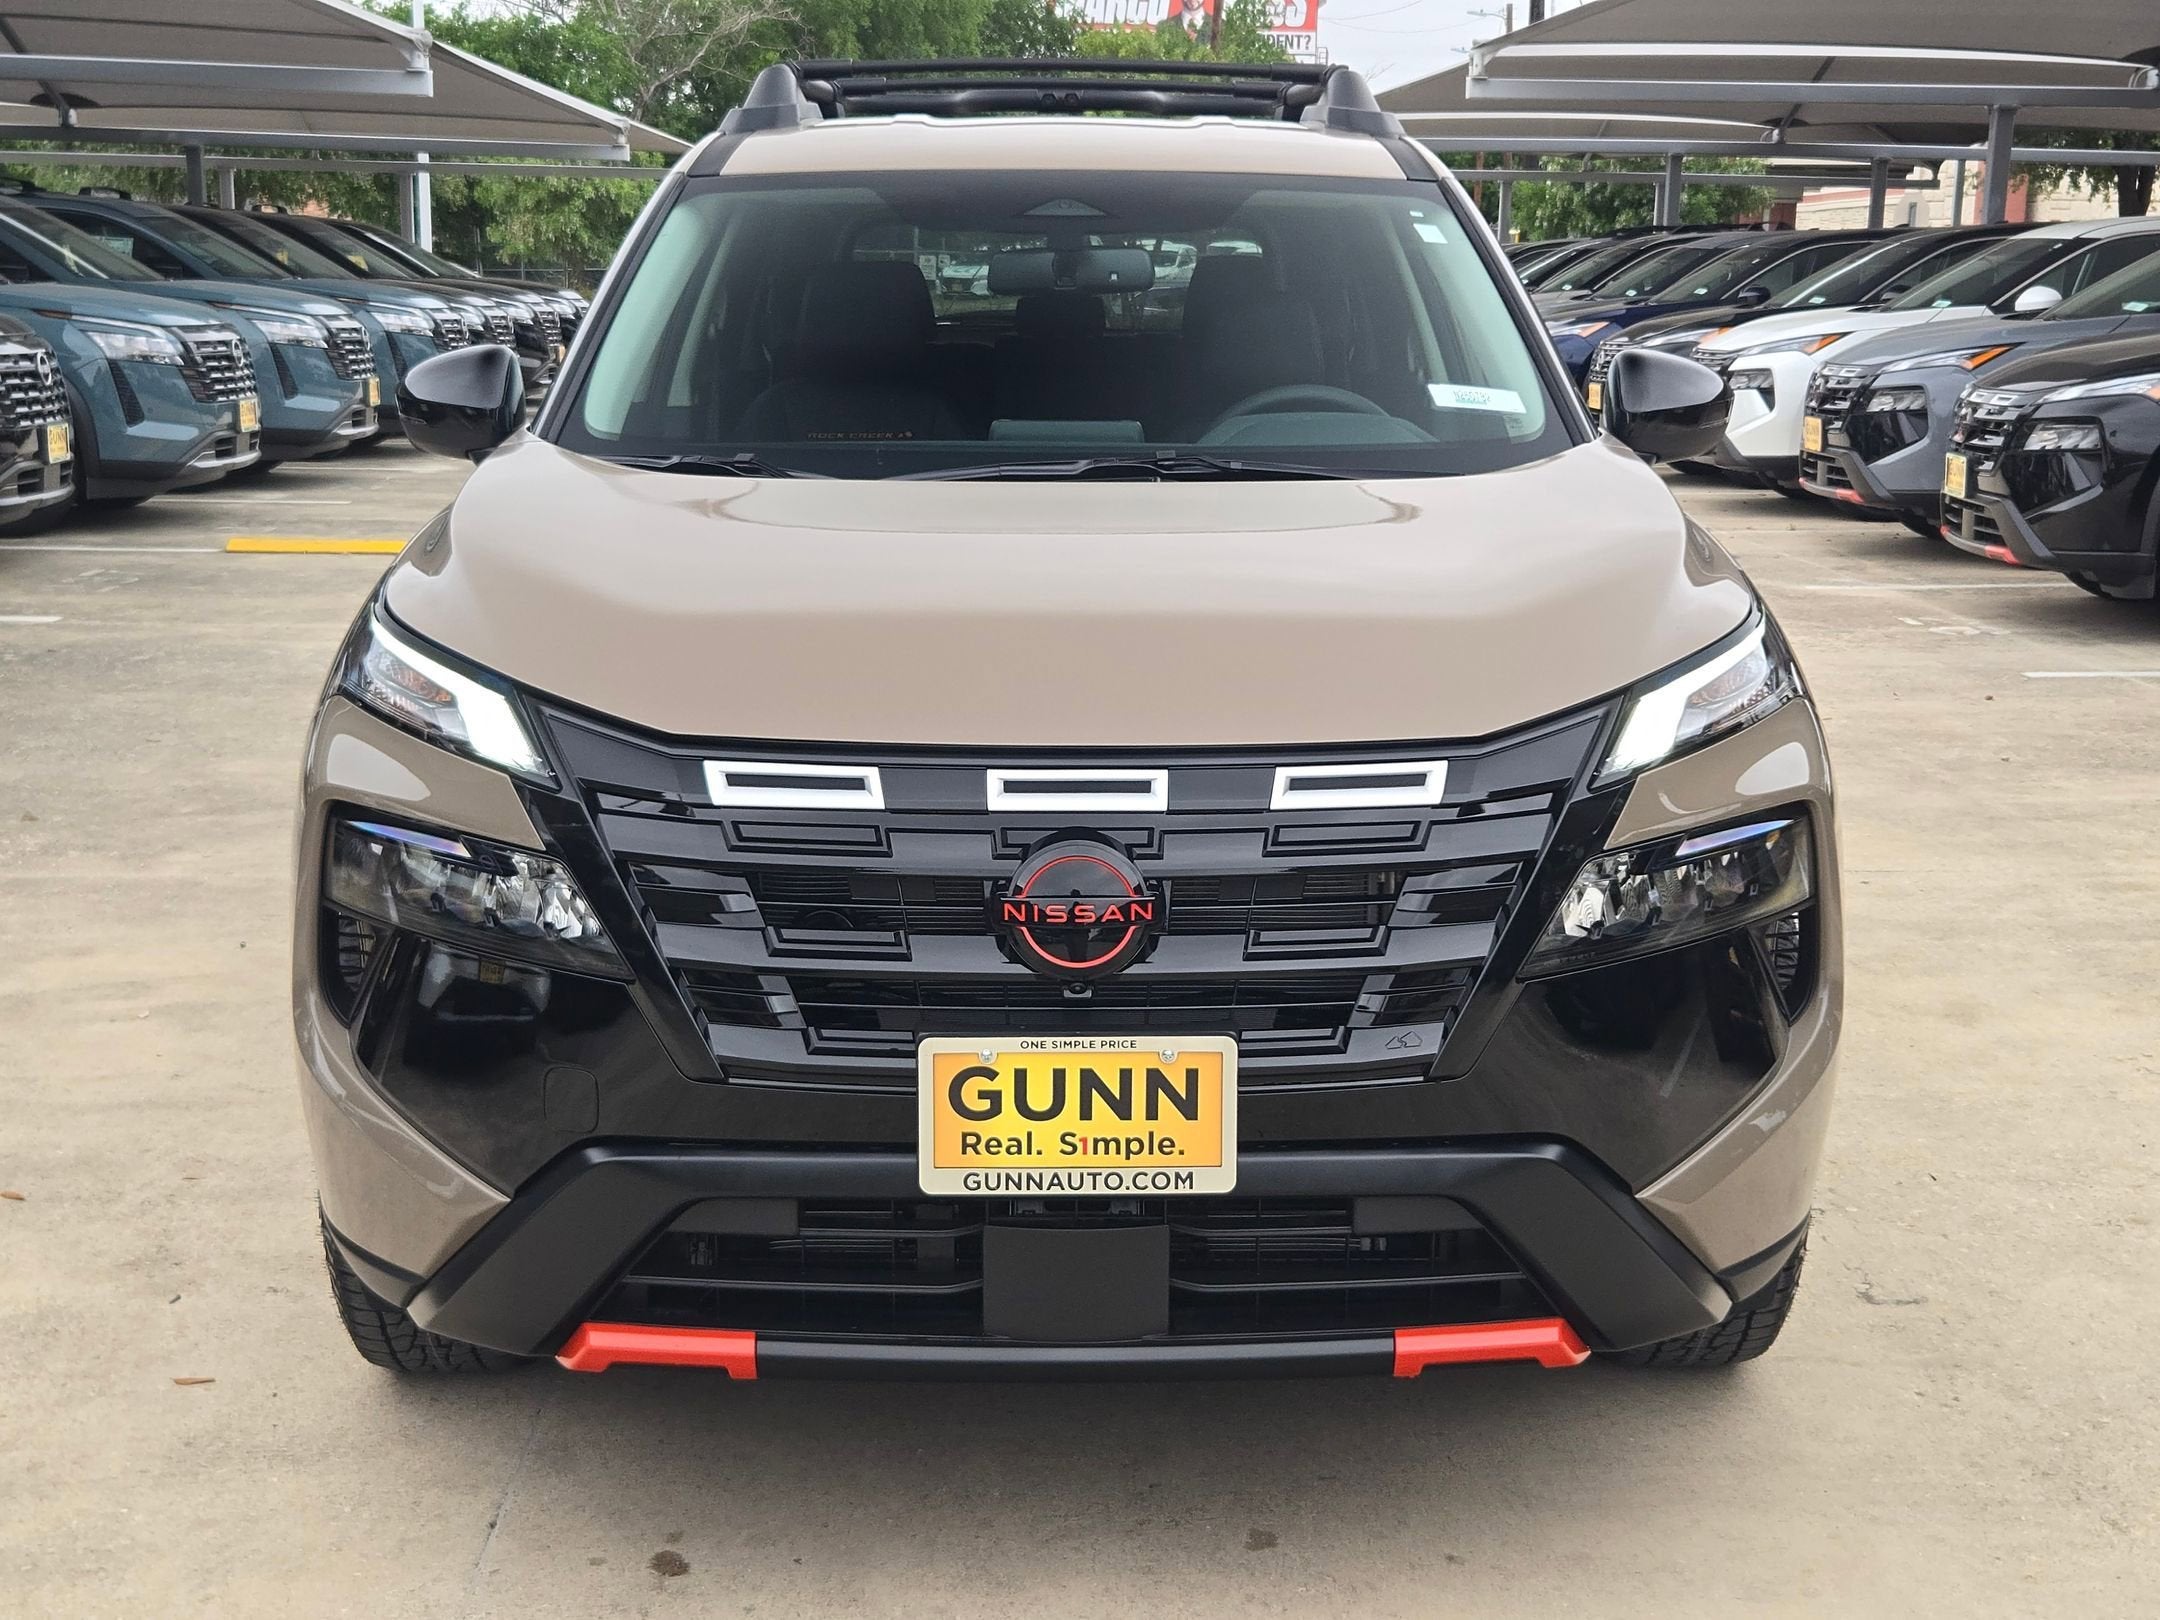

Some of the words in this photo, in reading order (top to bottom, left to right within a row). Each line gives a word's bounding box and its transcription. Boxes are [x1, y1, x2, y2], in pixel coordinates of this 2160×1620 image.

[1003, 902, 1153, 923] NISSAN
[1020, 1040, 1047, 1050] ONE
[1051, 1040, 1096, 1050] SIMPLE
[1100, 1040, 1137, 1049] PRICE
[948, 1066, 1199, 1121] GUNN
[961, 1131, 1043, 1156] Real.
[963, 1171, 1194, 1191] GUNNAUTO.COM
